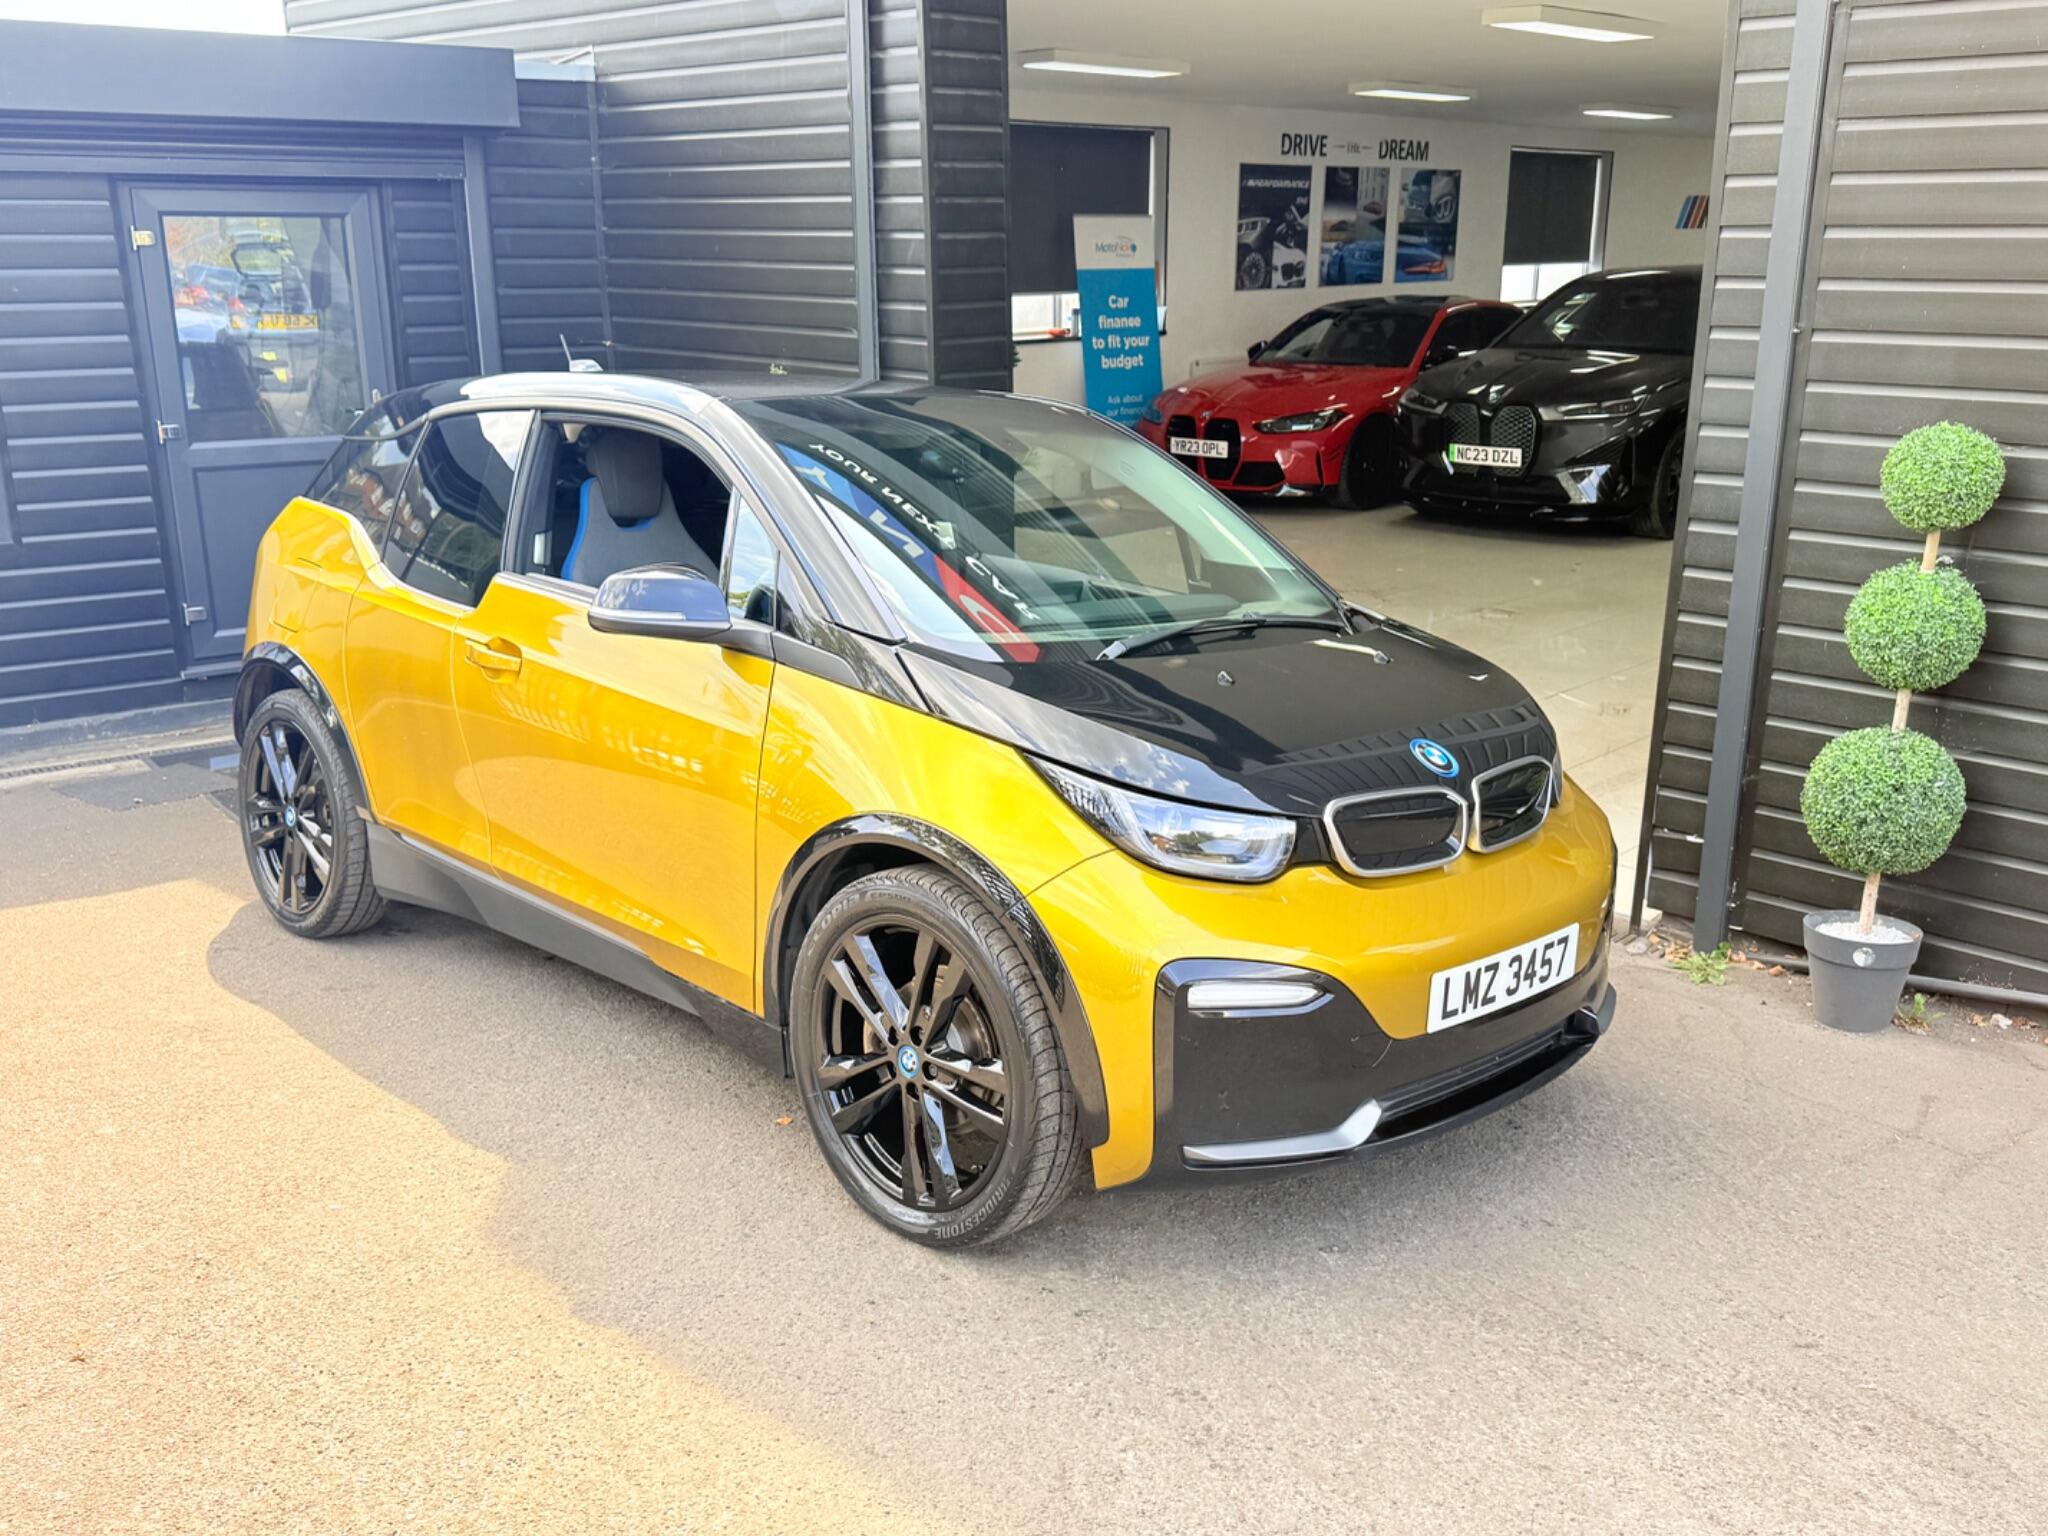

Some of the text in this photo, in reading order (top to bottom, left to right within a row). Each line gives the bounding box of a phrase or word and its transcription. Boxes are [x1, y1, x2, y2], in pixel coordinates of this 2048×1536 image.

[1281, 133, 1328, 157] DRIVE
[1379, 139, 1429, 162] DREAM
[1108, 295, 1129, 308] Car
[1098, 315, 1141, 329] finance
[1092, 335, 1150, 350] to fit your
[1101, 354, 1144, 370] budget
[1175, 440, 1200, 453] YR23
[1457, 446, 1518, 464] NC23 DZL
[1441, 934, 1570, 1020] LMZ 3457
